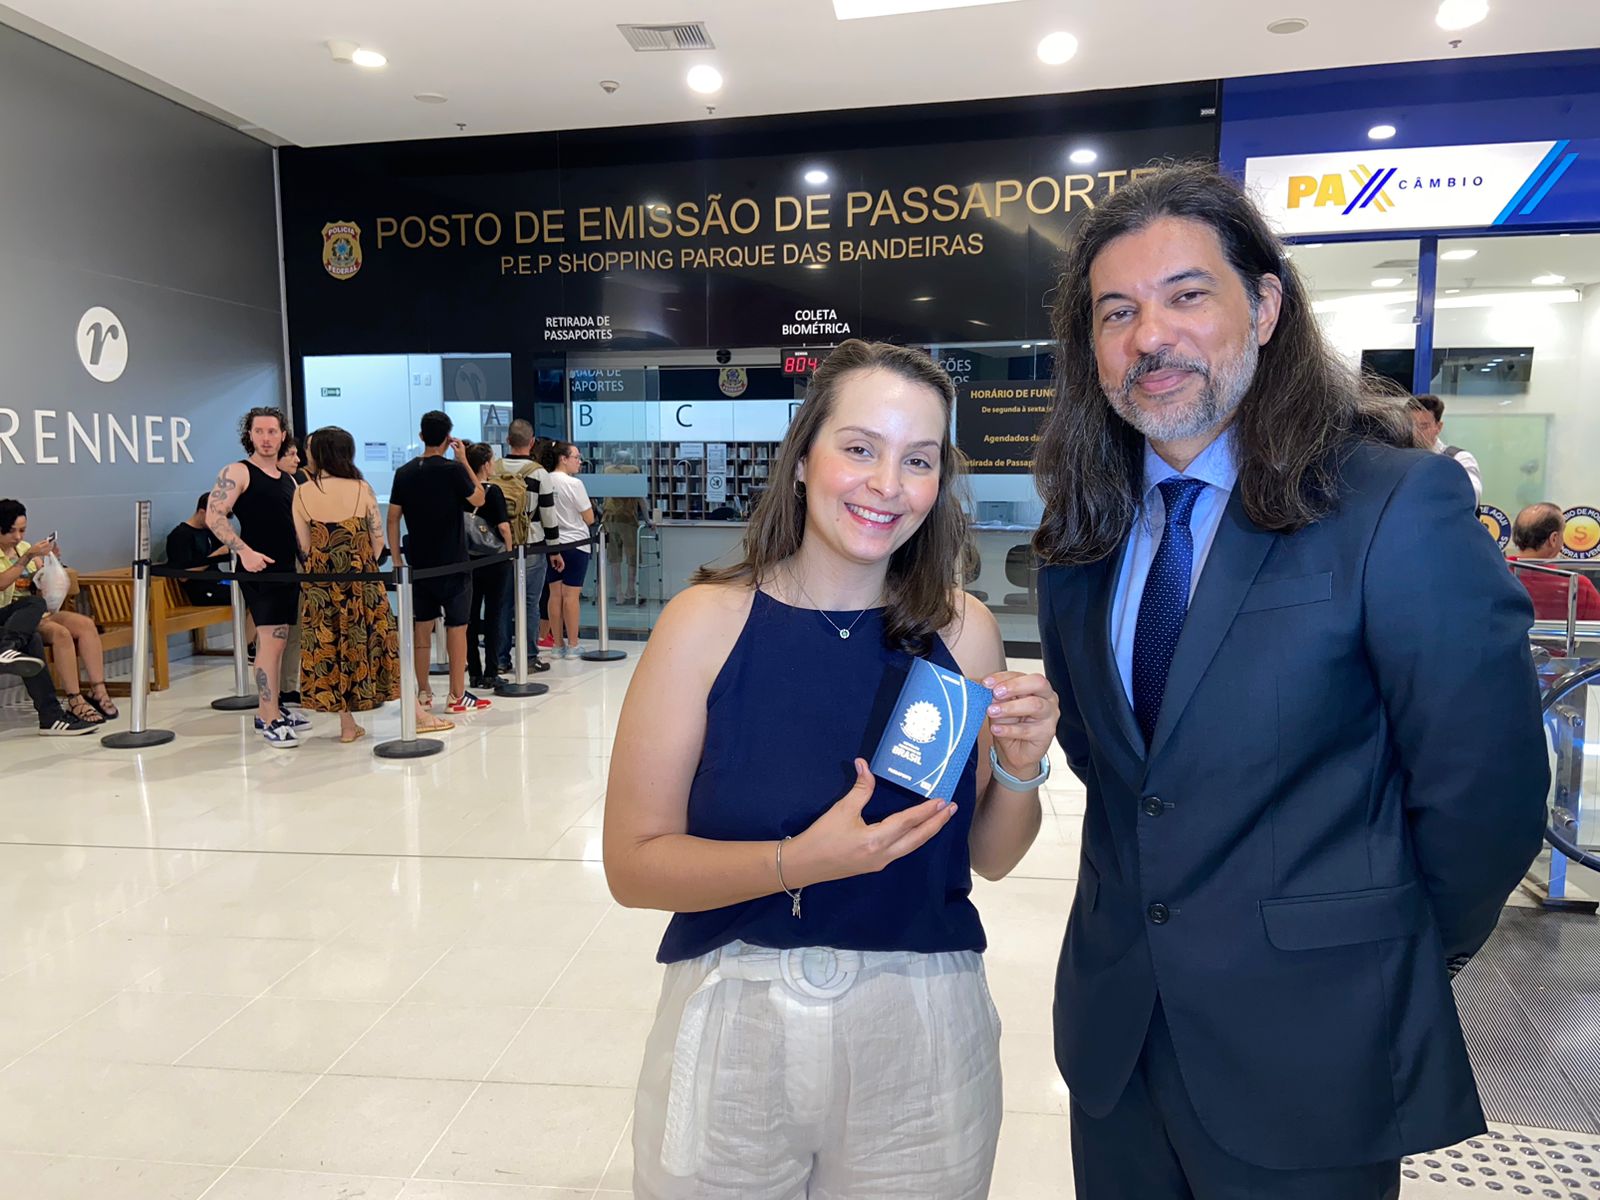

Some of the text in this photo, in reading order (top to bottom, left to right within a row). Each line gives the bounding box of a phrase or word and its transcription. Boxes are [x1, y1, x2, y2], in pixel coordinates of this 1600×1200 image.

[1287, 164, 1484, 215] PAX CÂMBIO
[376, 212, 502, 250] POSTO
[515, 208, 566, 244] DE
[579, 193, 761, 242] EMISSÃO
[775, 192, 831, 233] DE
[500, 232, 985, 277] P.E.P SHOPPING PARQUE DAS BANDEIRAS
[545, 315, 611, 329] RETIRADA DE
[794, 309, 837, 321] COLETA
[543, 328, 613, 341] PASSAPORTES
[782, 321, 851, 336] BIOMÉTRICA
[784, 356, 818, 374] 804
[572, 380, 625, 392] APORTES
[970, 388, 1014, 399] HORÁRIO
[1016, 389, 1029, 399] DE
[485, 404, 501, 425] A
[579, 404, 593, 426] B
[676, 404, 693, 428] C
[992, 406, 1021, 415] segunda
[0, 407, 195, 464] RENNER
[983, 434, 1029, 444] Agendados
[994, 458, 1005, 467] de
[891, 745, 922, 766] BRASIL
